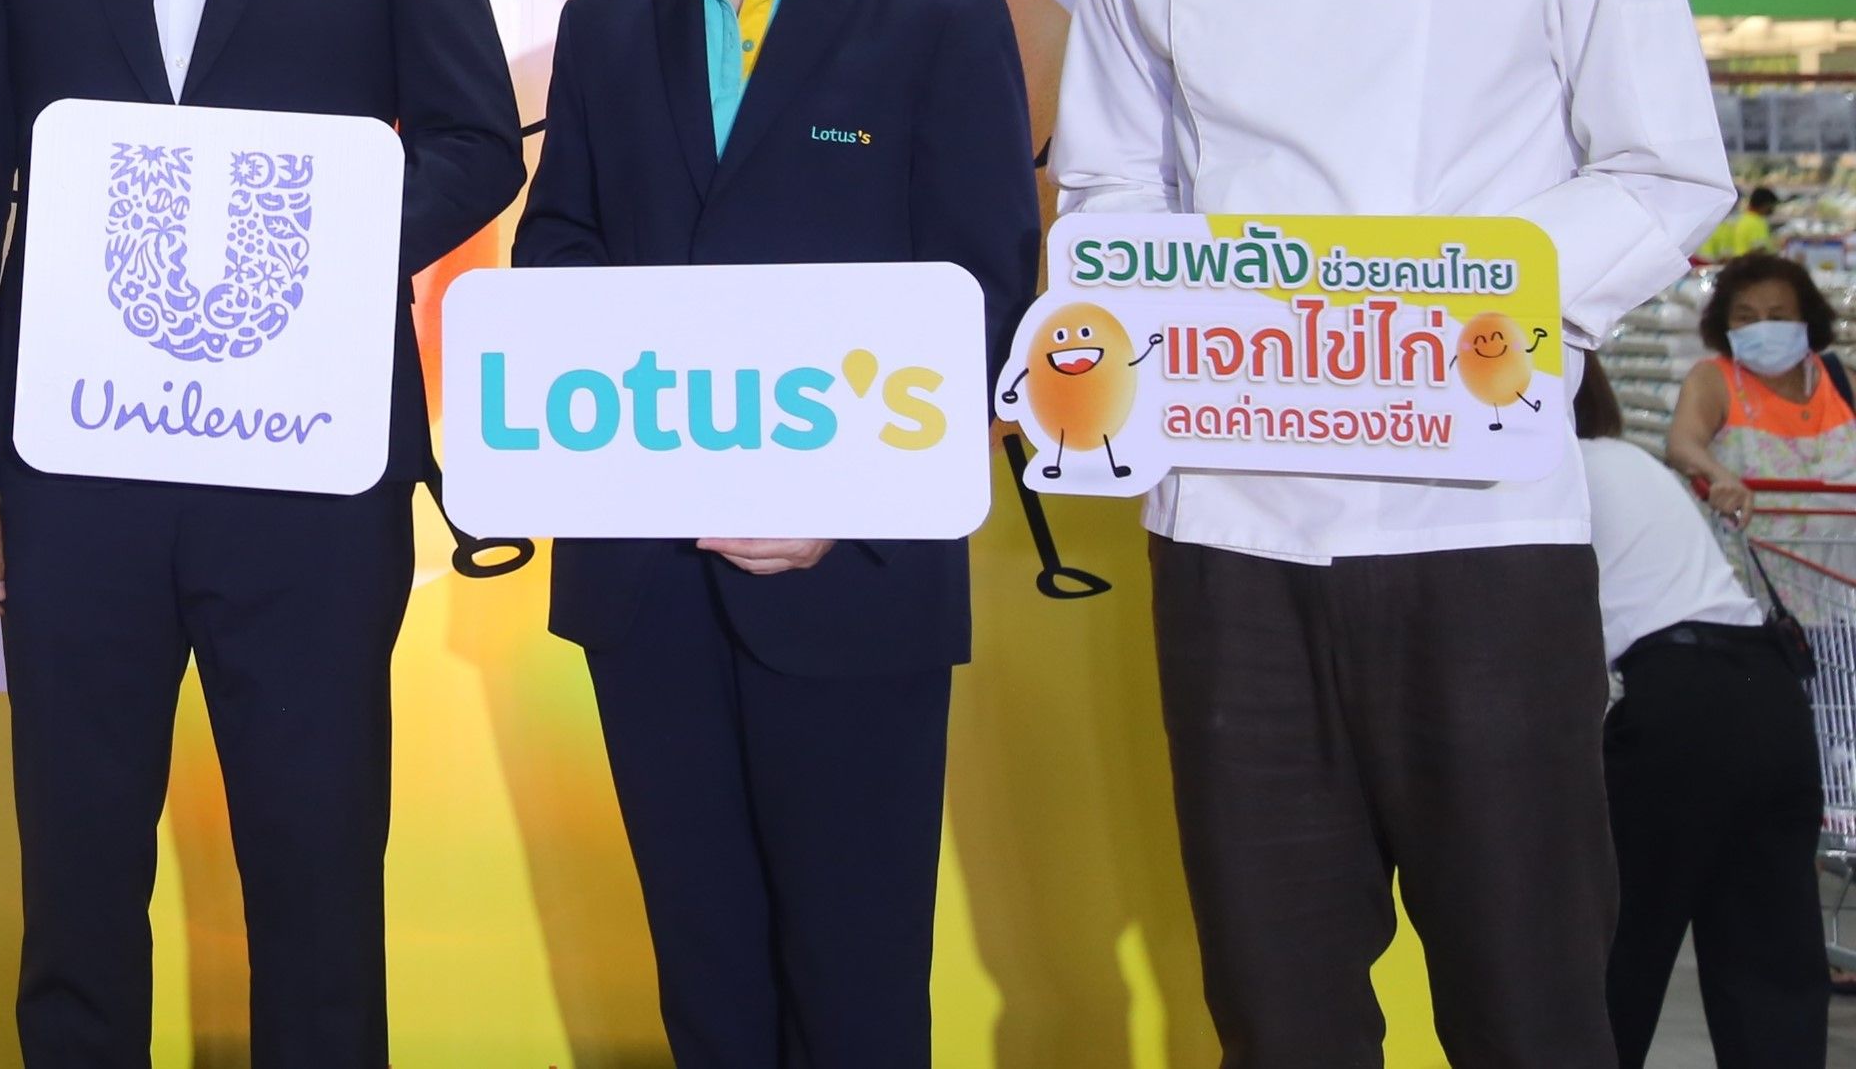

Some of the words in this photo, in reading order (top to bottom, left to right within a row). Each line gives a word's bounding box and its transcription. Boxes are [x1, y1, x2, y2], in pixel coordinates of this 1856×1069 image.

[811, 125, 872, 145] Lotus's
[1074, 226, 1310, 285] รวมพลัง
[1321, 246, 1515, 291] ช่วยคนไทย
[1164, 298, 1448, 384] แจกไข่ไก่
[70, 378, 334, 446] Unilever
[480, 348, 947, 453] Lotus's
[1165, 396, 1453, 445] ลดค่าครองชีพ
